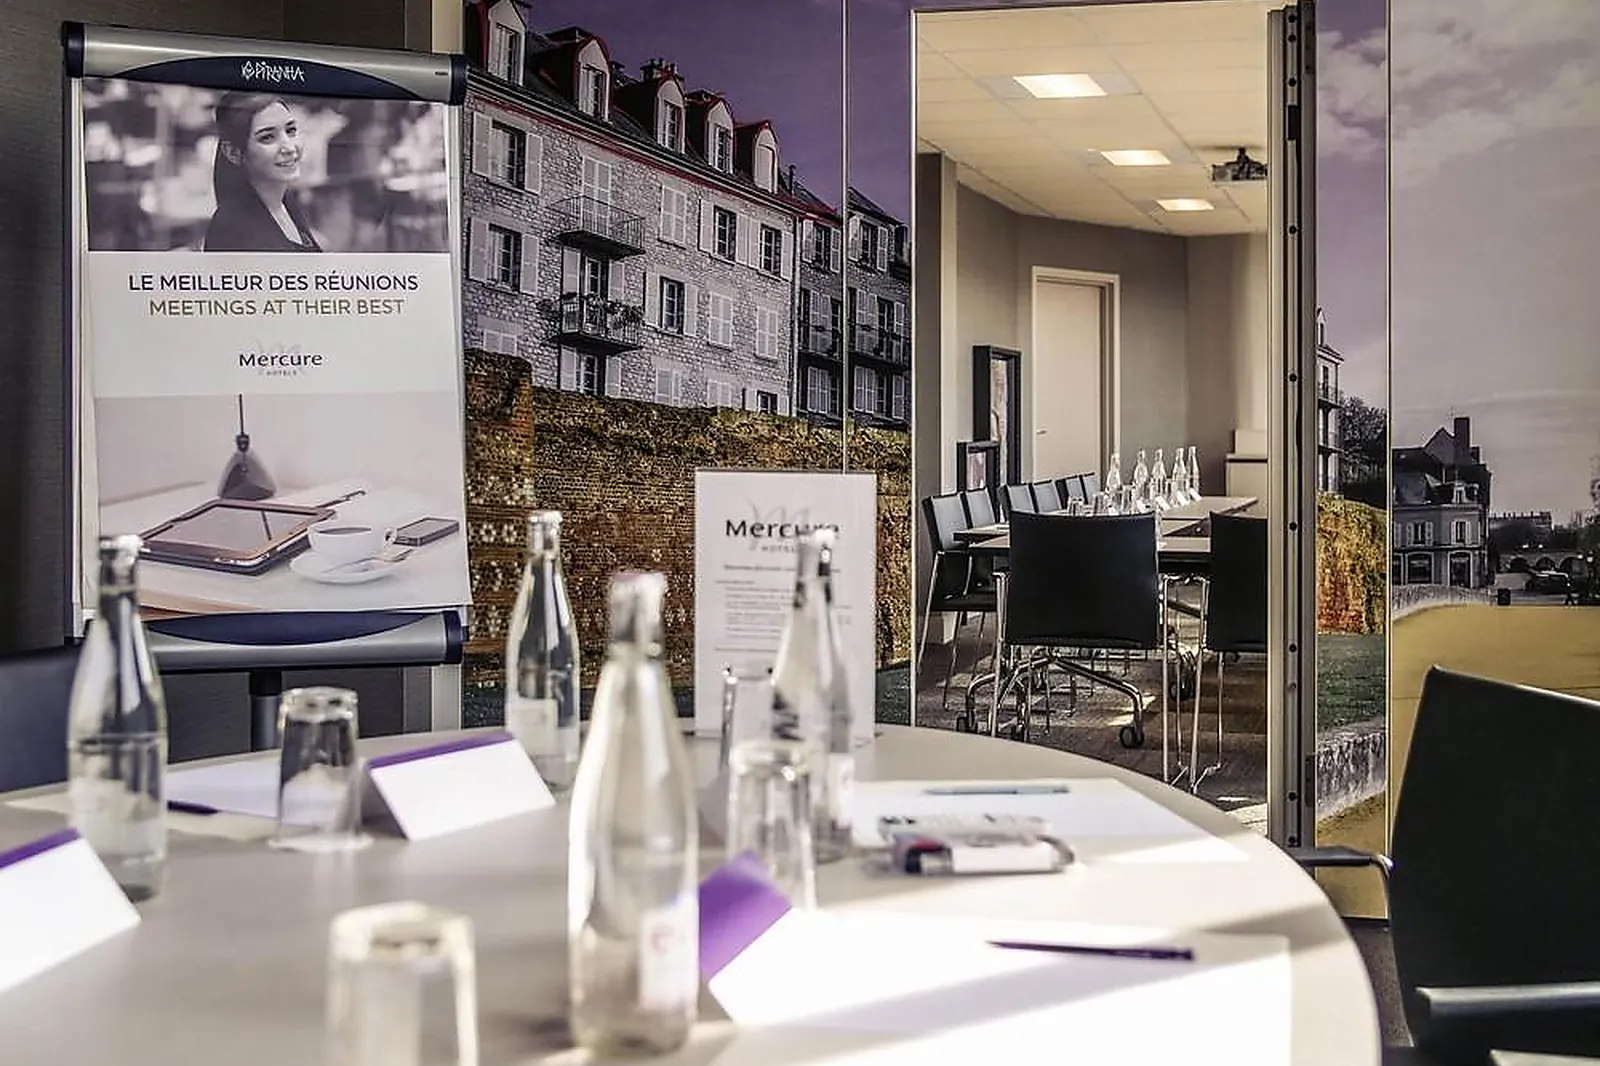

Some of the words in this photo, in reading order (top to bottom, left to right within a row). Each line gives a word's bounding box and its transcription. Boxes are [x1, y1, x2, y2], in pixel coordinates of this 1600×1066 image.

[129, 275, 154, 290] LE
[160, 275, 263, 290] MEILLEUR
[269, 275, 308, 290] DES
[315, 270, 419, 290] RÉUNIONS
[149, 300, 257, 315] MEETINGS
[263, 300, 287, 314] AT
[292, 299, 351, 314] THEIR
[357, 299, 405, 314] BEST
[239, 354, 323, 367] Mercure
